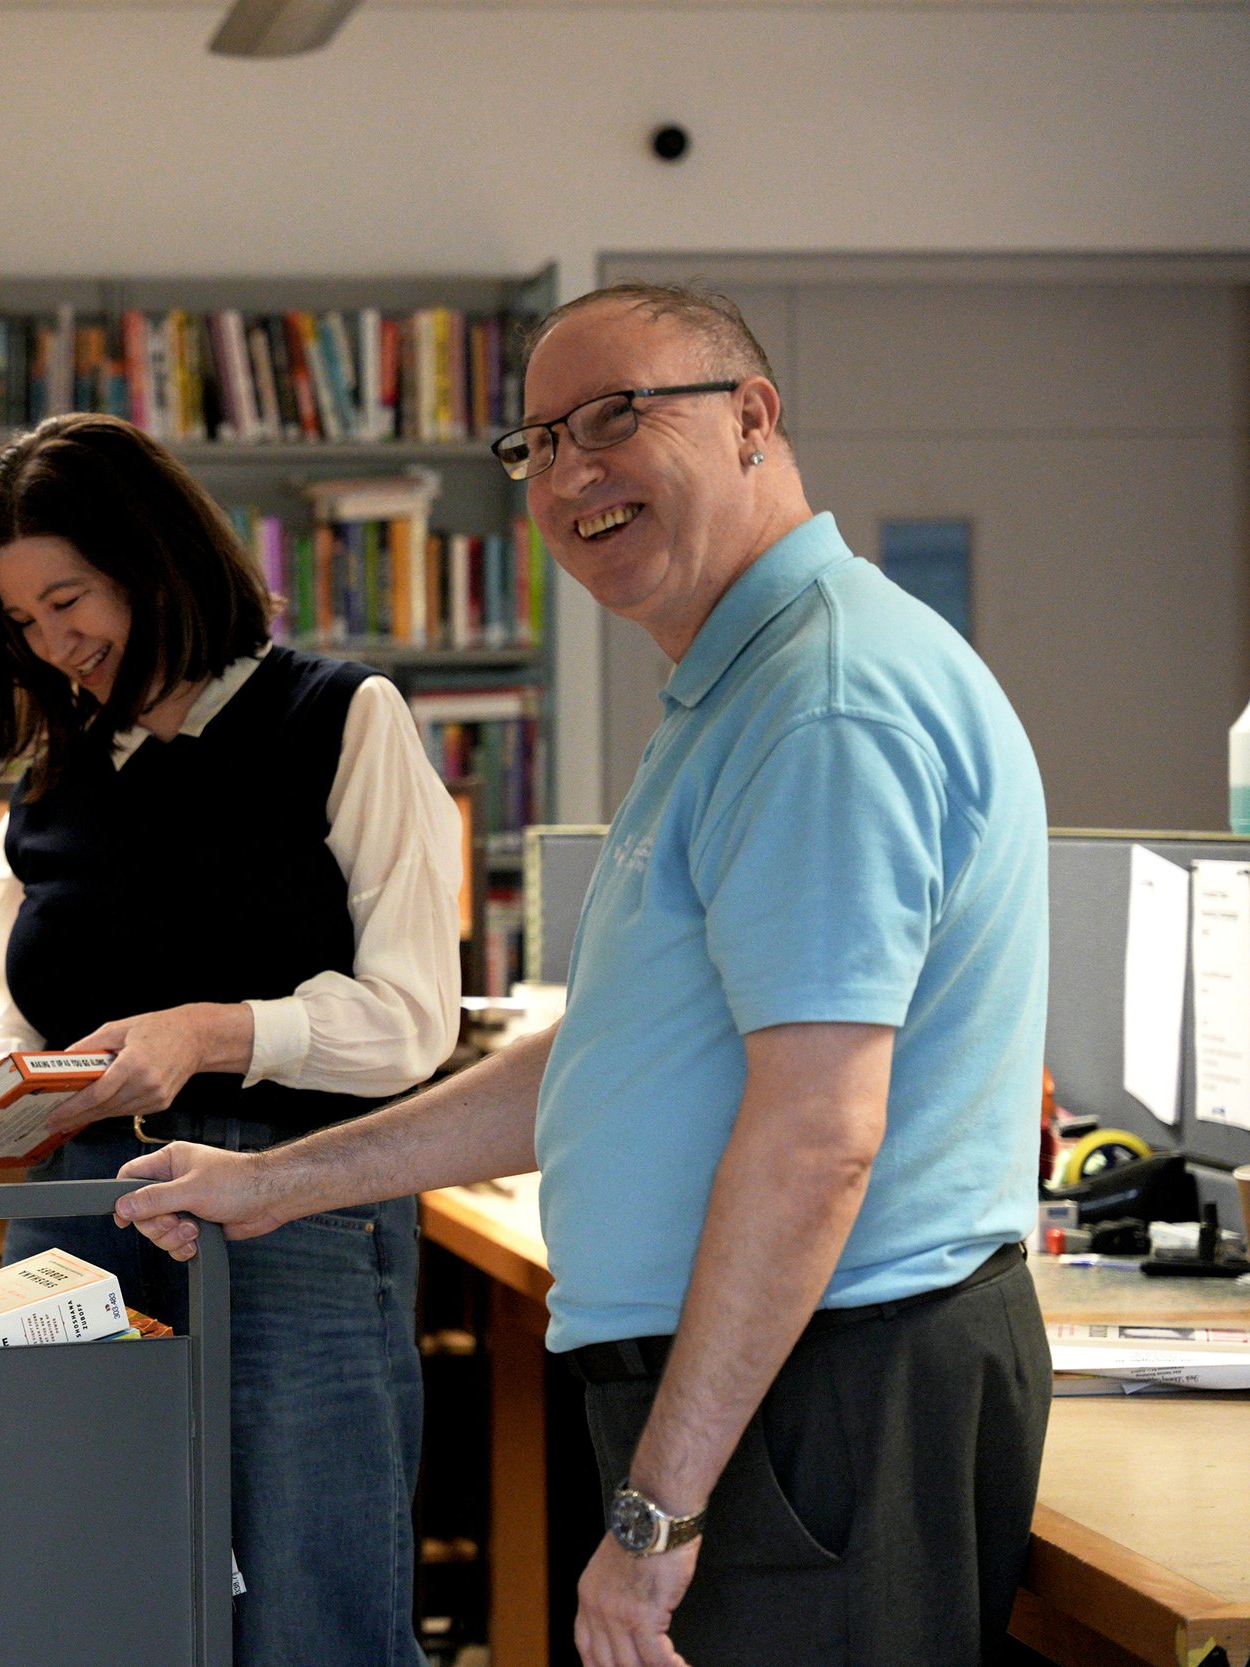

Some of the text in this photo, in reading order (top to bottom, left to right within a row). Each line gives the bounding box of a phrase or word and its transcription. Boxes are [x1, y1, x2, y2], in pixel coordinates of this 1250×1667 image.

[31, 1060, 50, 1068] MAKING
[56, 1059, 63, 1067] UP
[71, 1059, 83, 1067] YOU
[82, 1059, 91, 1067] GO
[90, 1058, 107, 1066] ALONG
[18, 1270, 58, 1289] SHOSHANA
[37, 1267, 69, 1281] ZUBOFF
[76, 1303, 88, 1330] ZUBOFF
[108, 1292, 121, 1320] 303.483
[68, 1300, 82, 1338] SHOSHANA
